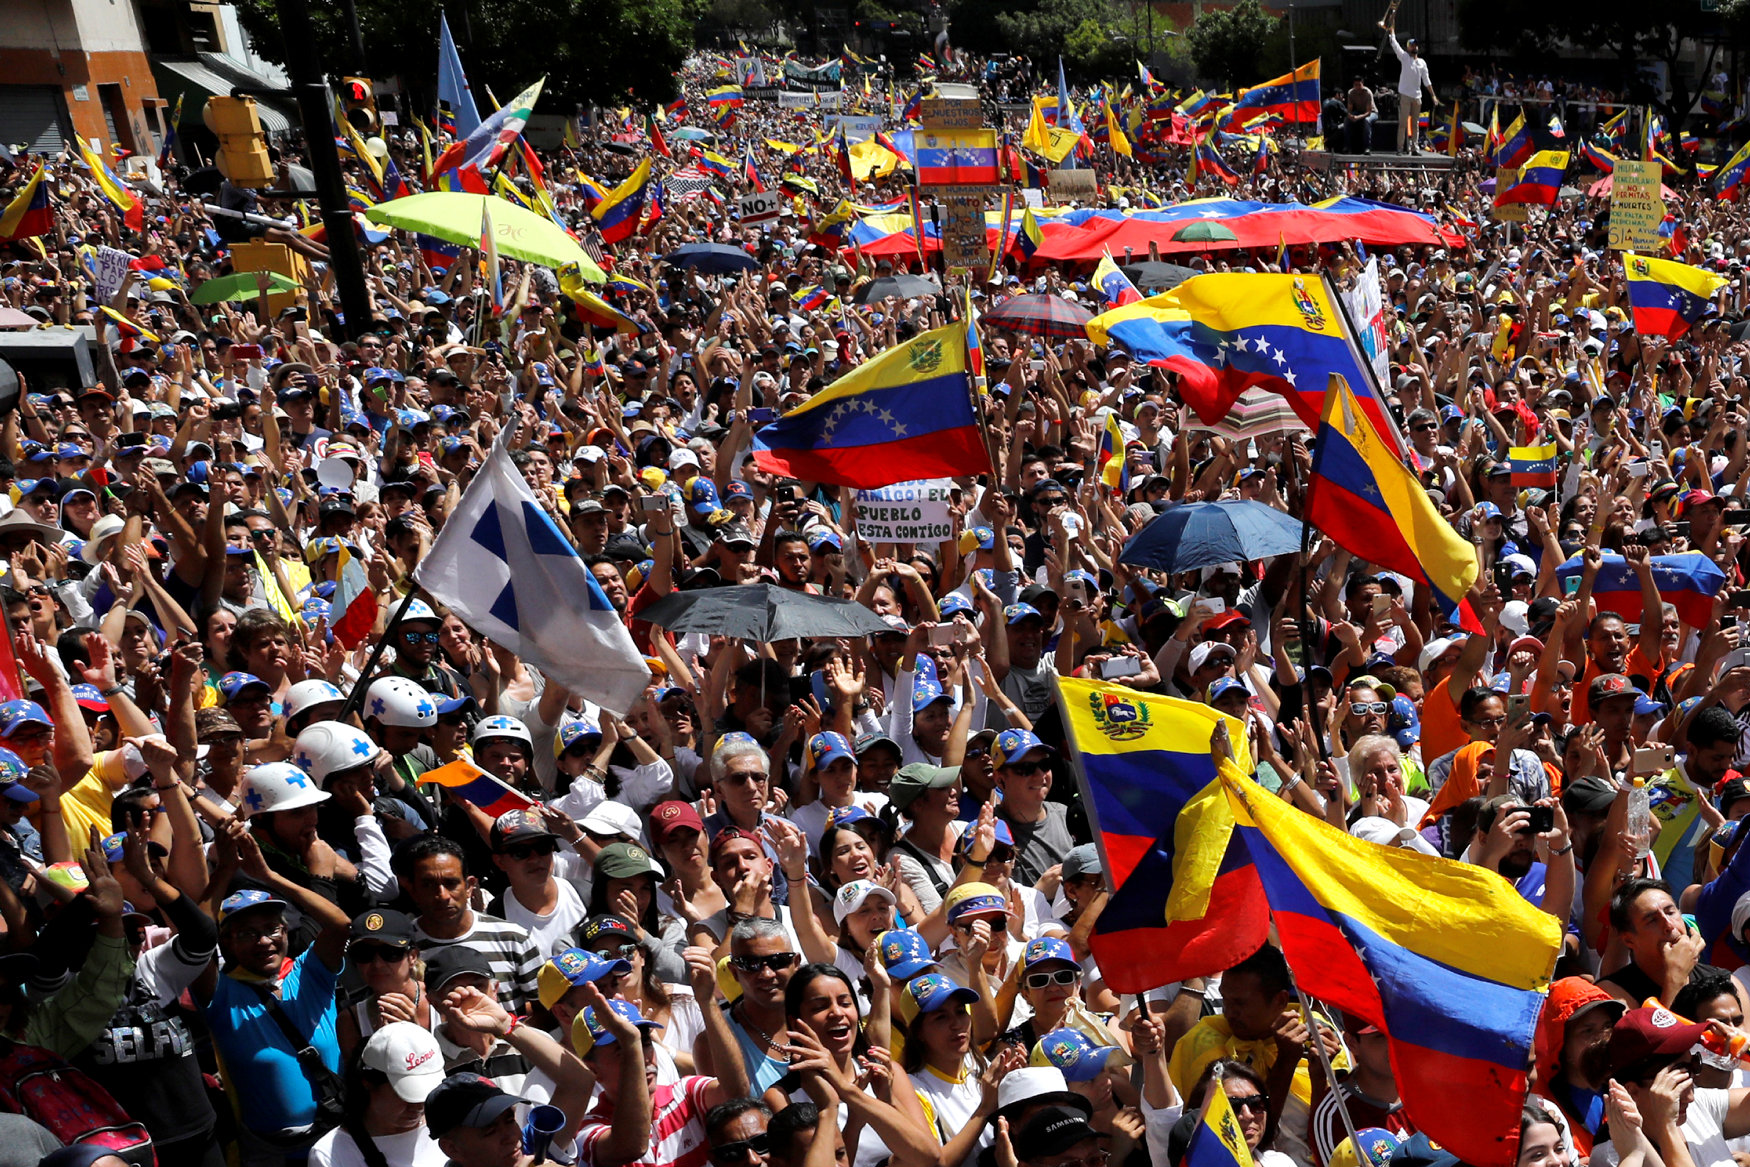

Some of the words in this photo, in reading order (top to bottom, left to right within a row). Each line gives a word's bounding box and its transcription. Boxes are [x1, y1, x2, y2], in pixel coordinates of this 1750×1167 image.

[1615, 191, 1651, 200] PERMITAS
[1618, 202, 1652, 211] MUERTES
[858, 505, 921, 521] PUEBLO
[857, 523, 893, 538] ESTA
[94, 1016, 193, 1065] SELFIE
